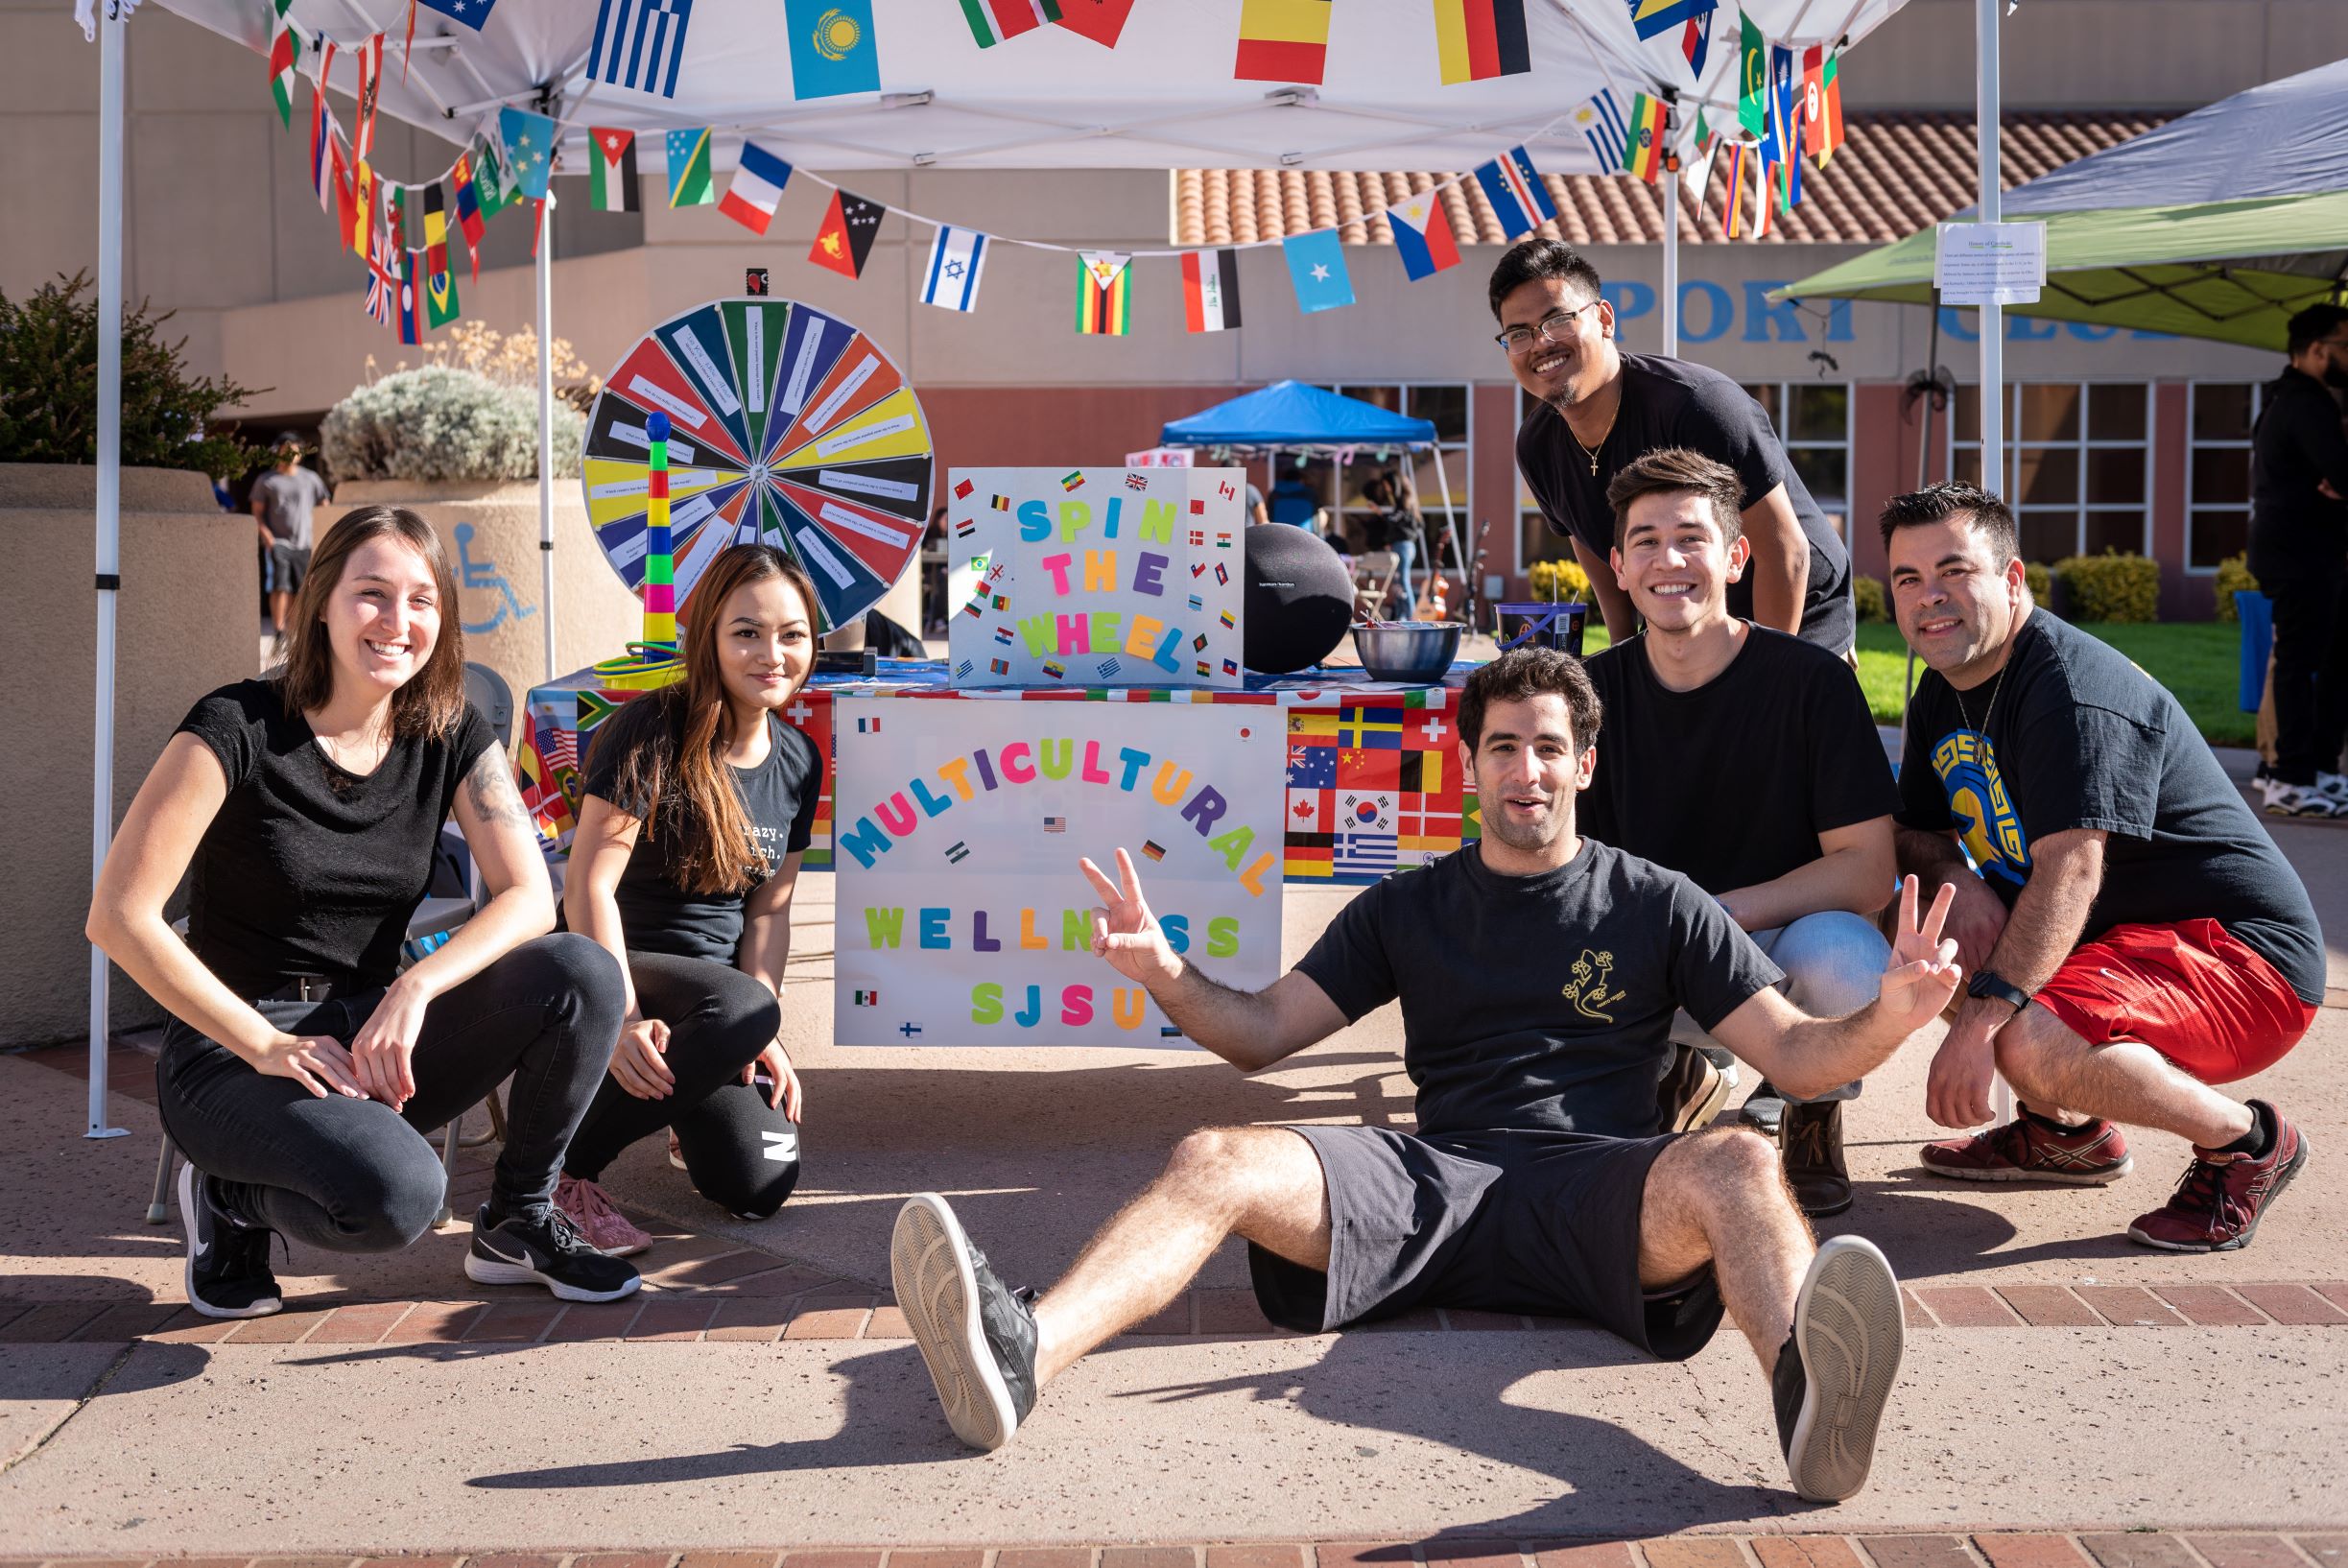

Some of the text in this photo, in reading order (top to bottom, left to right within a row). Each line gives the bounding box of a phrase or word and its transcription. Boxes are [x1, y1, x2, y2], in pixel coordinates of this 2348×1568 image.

[1016, 496, 1177, 544] SPIN
[1042, 551, 1169, 596] THE
[1017, 611, 1184, 674] WHEEL
[839, 738, 1277, 898] MULTICULTURAL
[865, 907, 1240, 959] WELLNSS
[970, 983, 1146, 1030] SJSU
